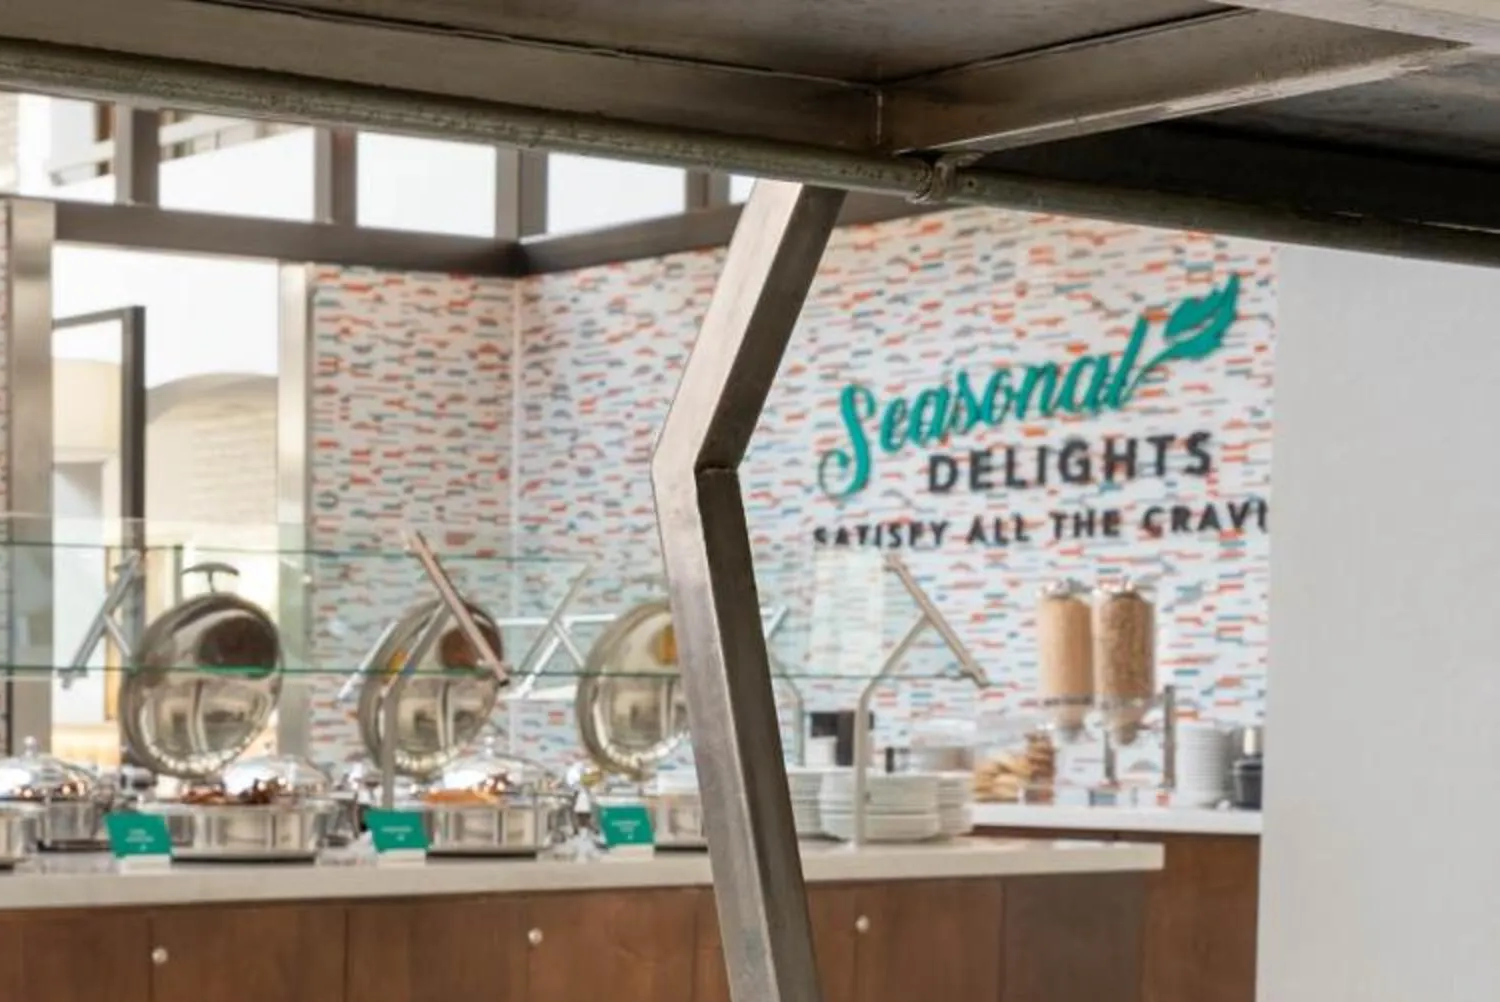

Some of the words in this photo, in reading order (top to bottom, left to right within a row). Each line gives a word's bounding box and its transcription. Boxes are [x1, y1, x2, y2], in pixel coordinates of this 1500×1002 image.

[818, 314, 1150, 499] Seasonal
[928, 431, 1212, 493] DELIGHTS
[813, 520, 950, 548] SATISFY
[967, 512, 1030, 547] ALL
[1050, 507, 1120, 541] THE
